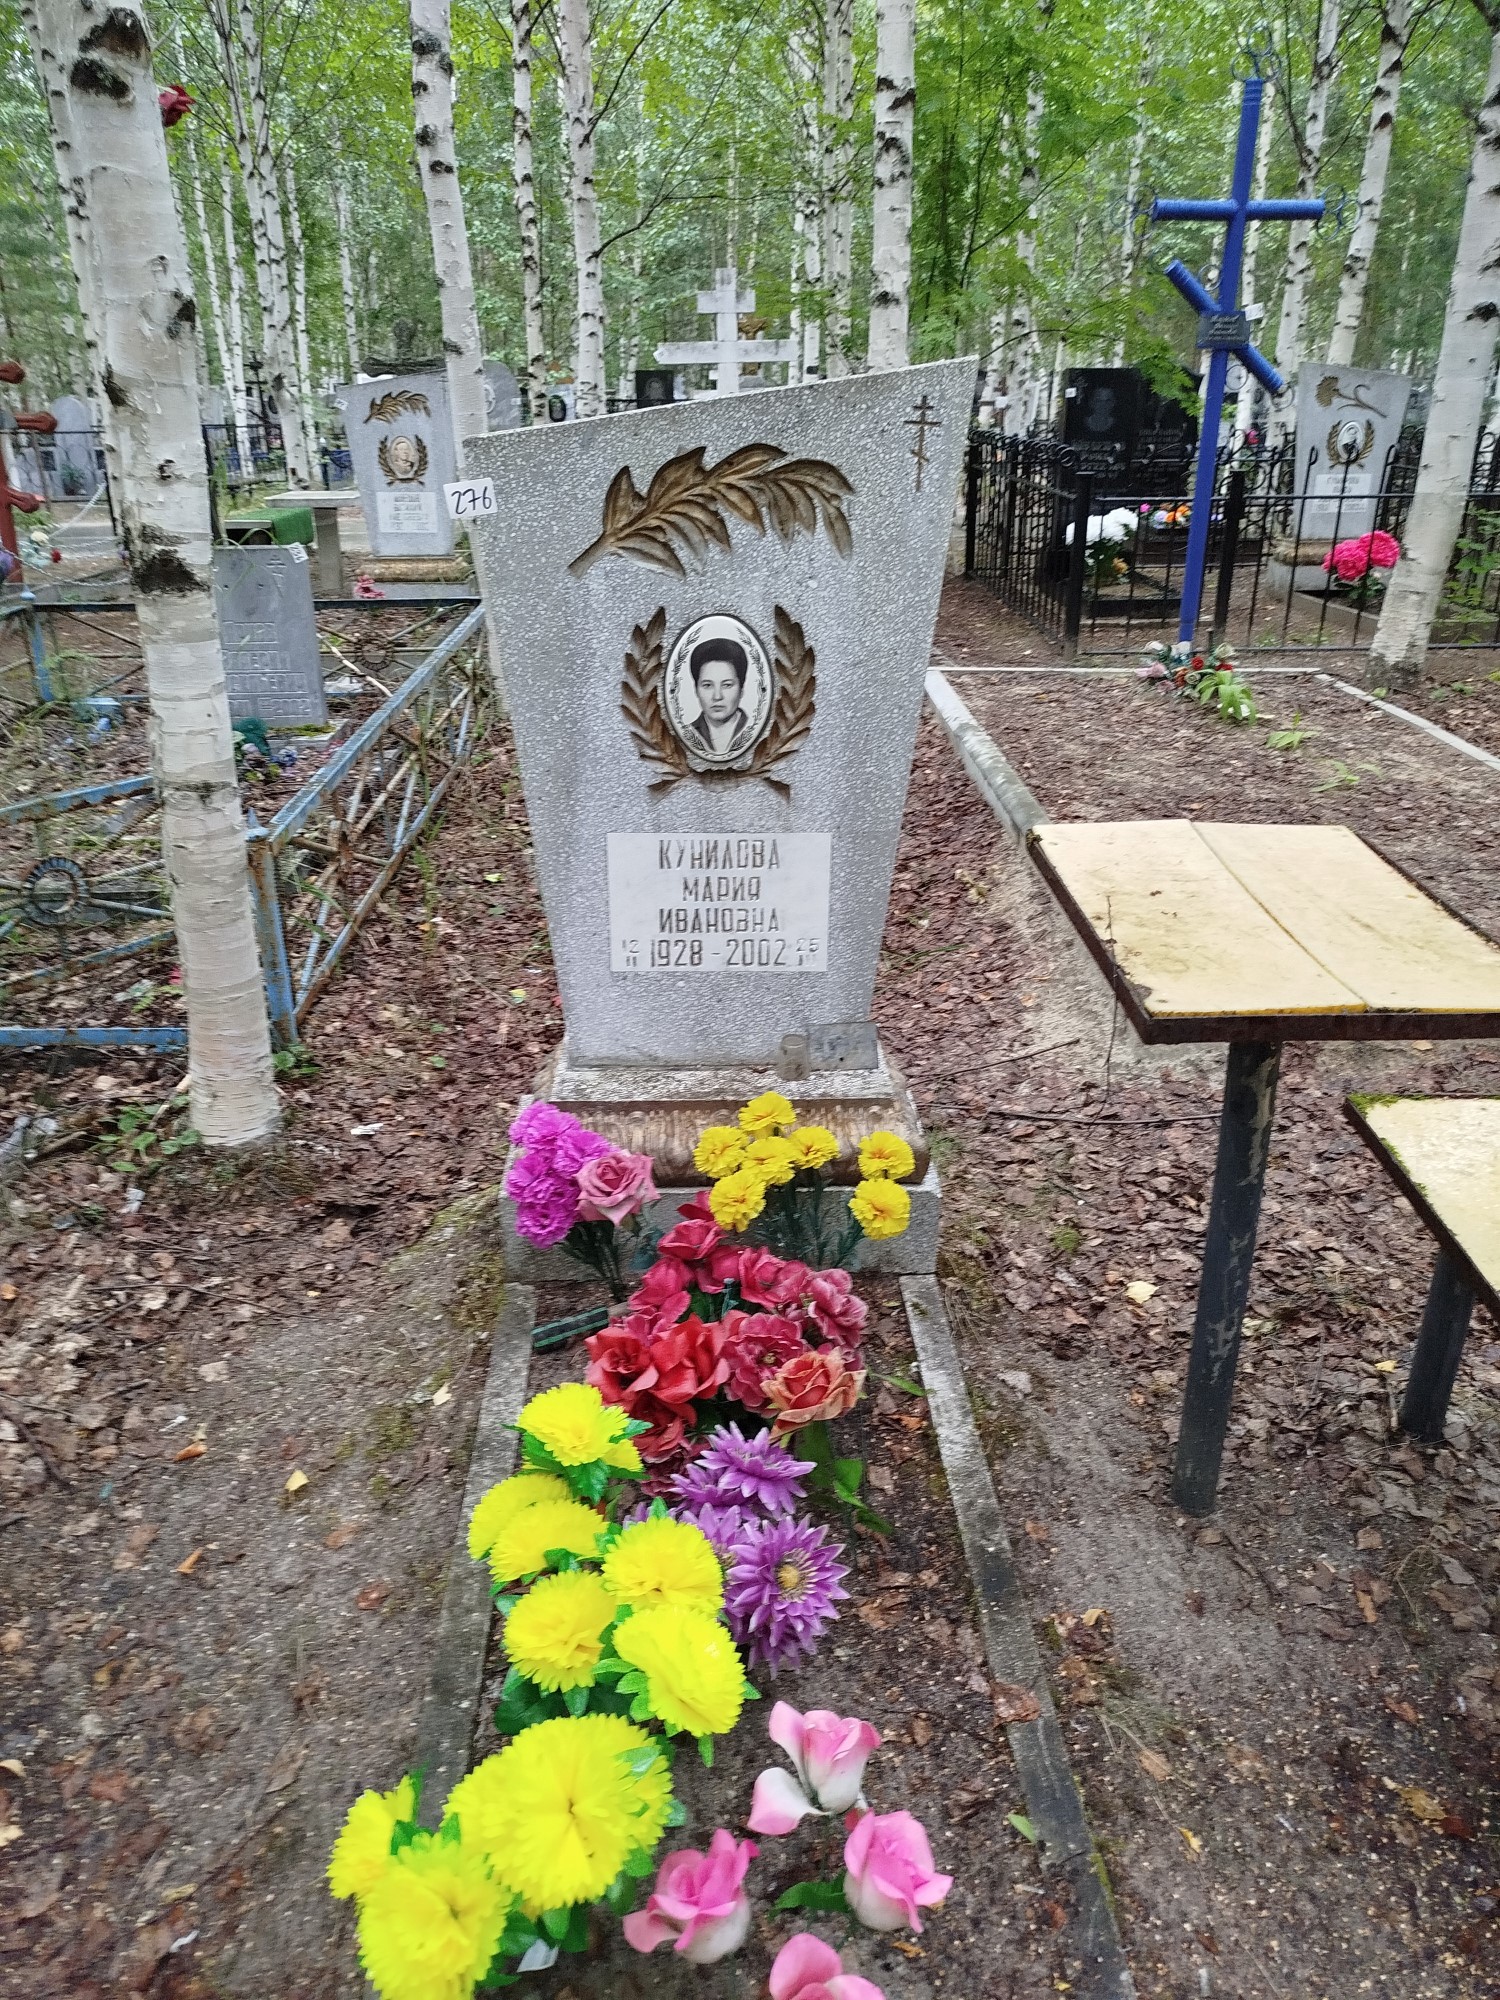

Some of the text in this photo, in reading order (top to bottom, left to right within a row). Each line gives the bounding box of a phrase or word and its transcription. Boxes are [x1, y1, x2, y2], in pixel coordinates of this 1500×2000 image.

[451, 486, 492, 514] 276
[658, 839, 780, 869] КУНИЛОВА
[682, 876, 760, 902] МАРИЯ
[658, 908, 779, 933] ИВАНОВНА
[651, 939, 702, 967] 1928
[726, 938, 786, 966] 2002
